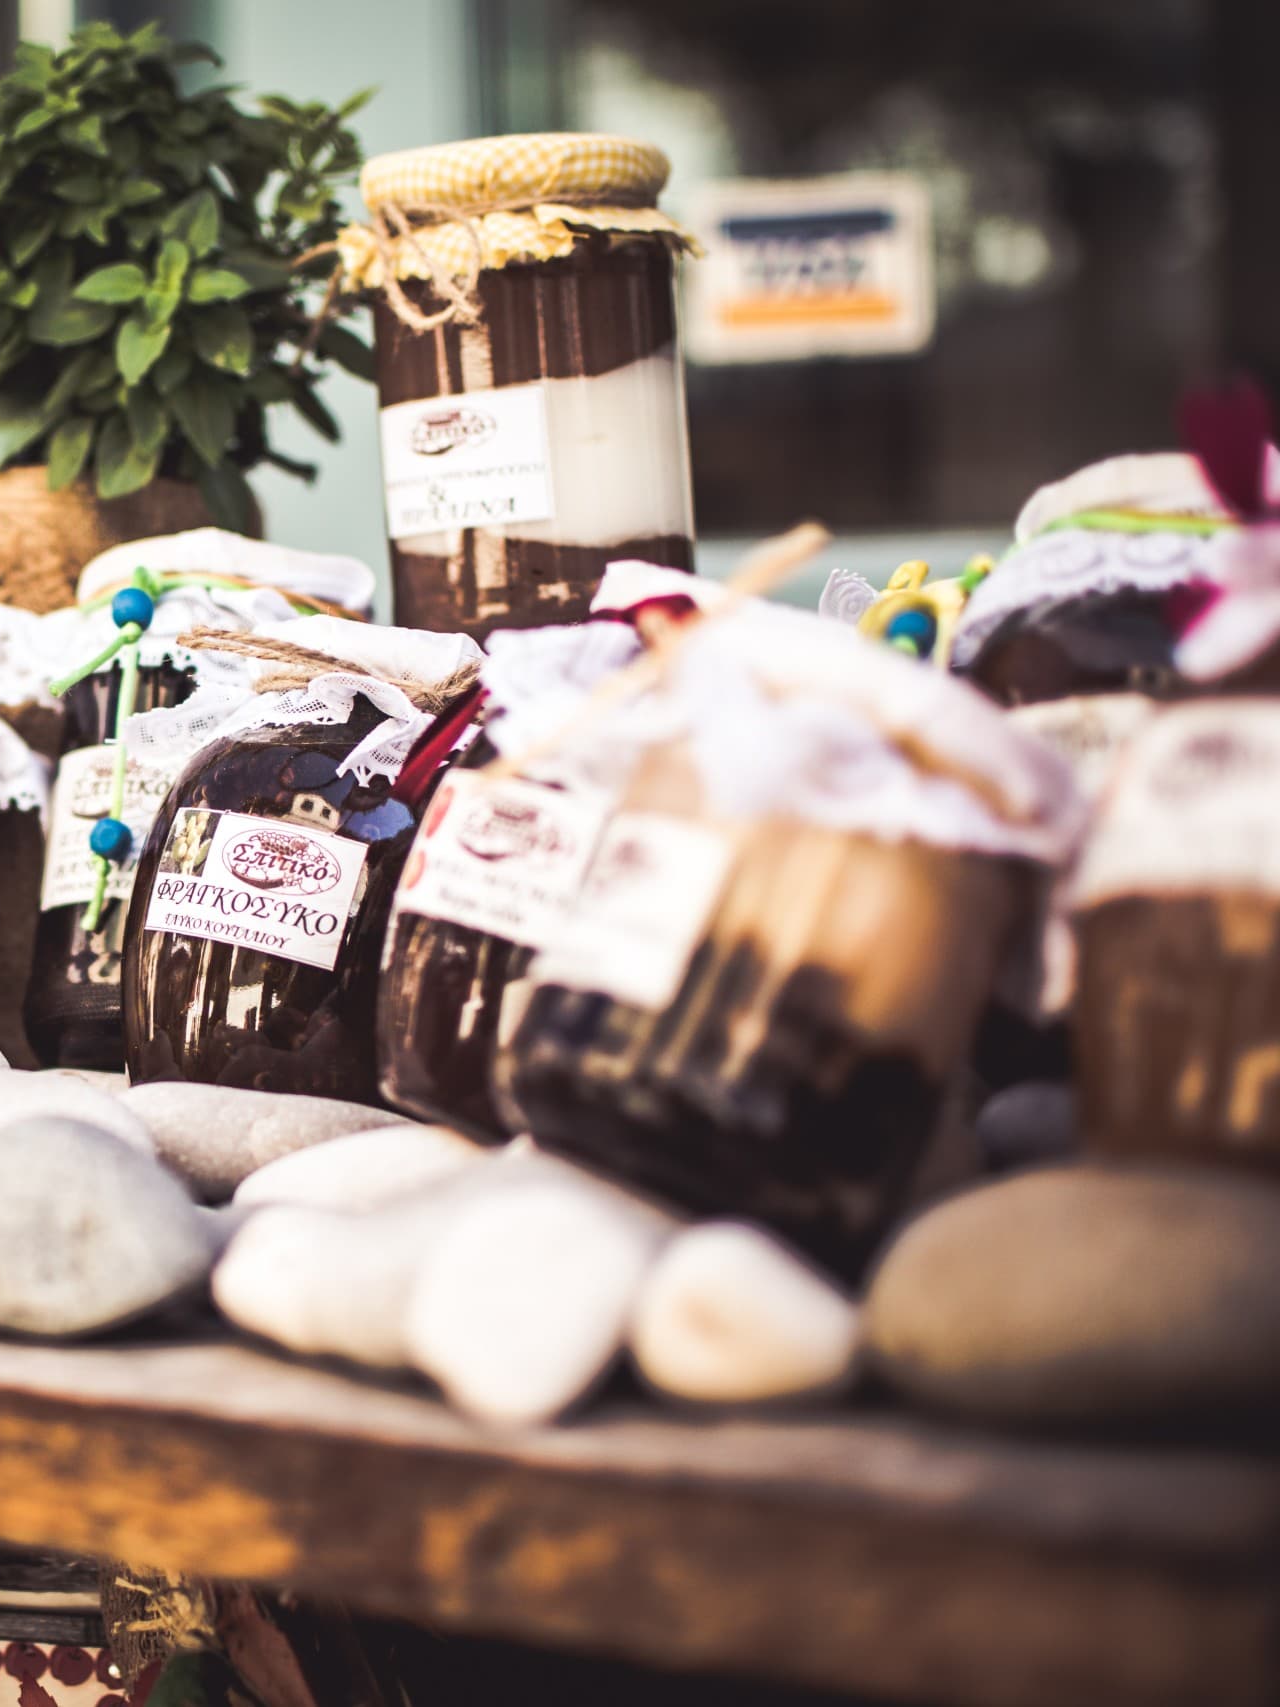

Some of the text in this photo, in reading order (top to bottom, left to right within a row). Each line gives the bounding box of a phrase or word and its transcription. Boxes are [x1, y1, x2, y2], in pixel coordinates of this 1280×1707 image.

[73, 773, 170, 800] Σπιικό
[232, 843, 330, 881] Σπιτικό
[157, 878, 338, 936] ΦΡΑΓΚΟΣΥΚΟ
